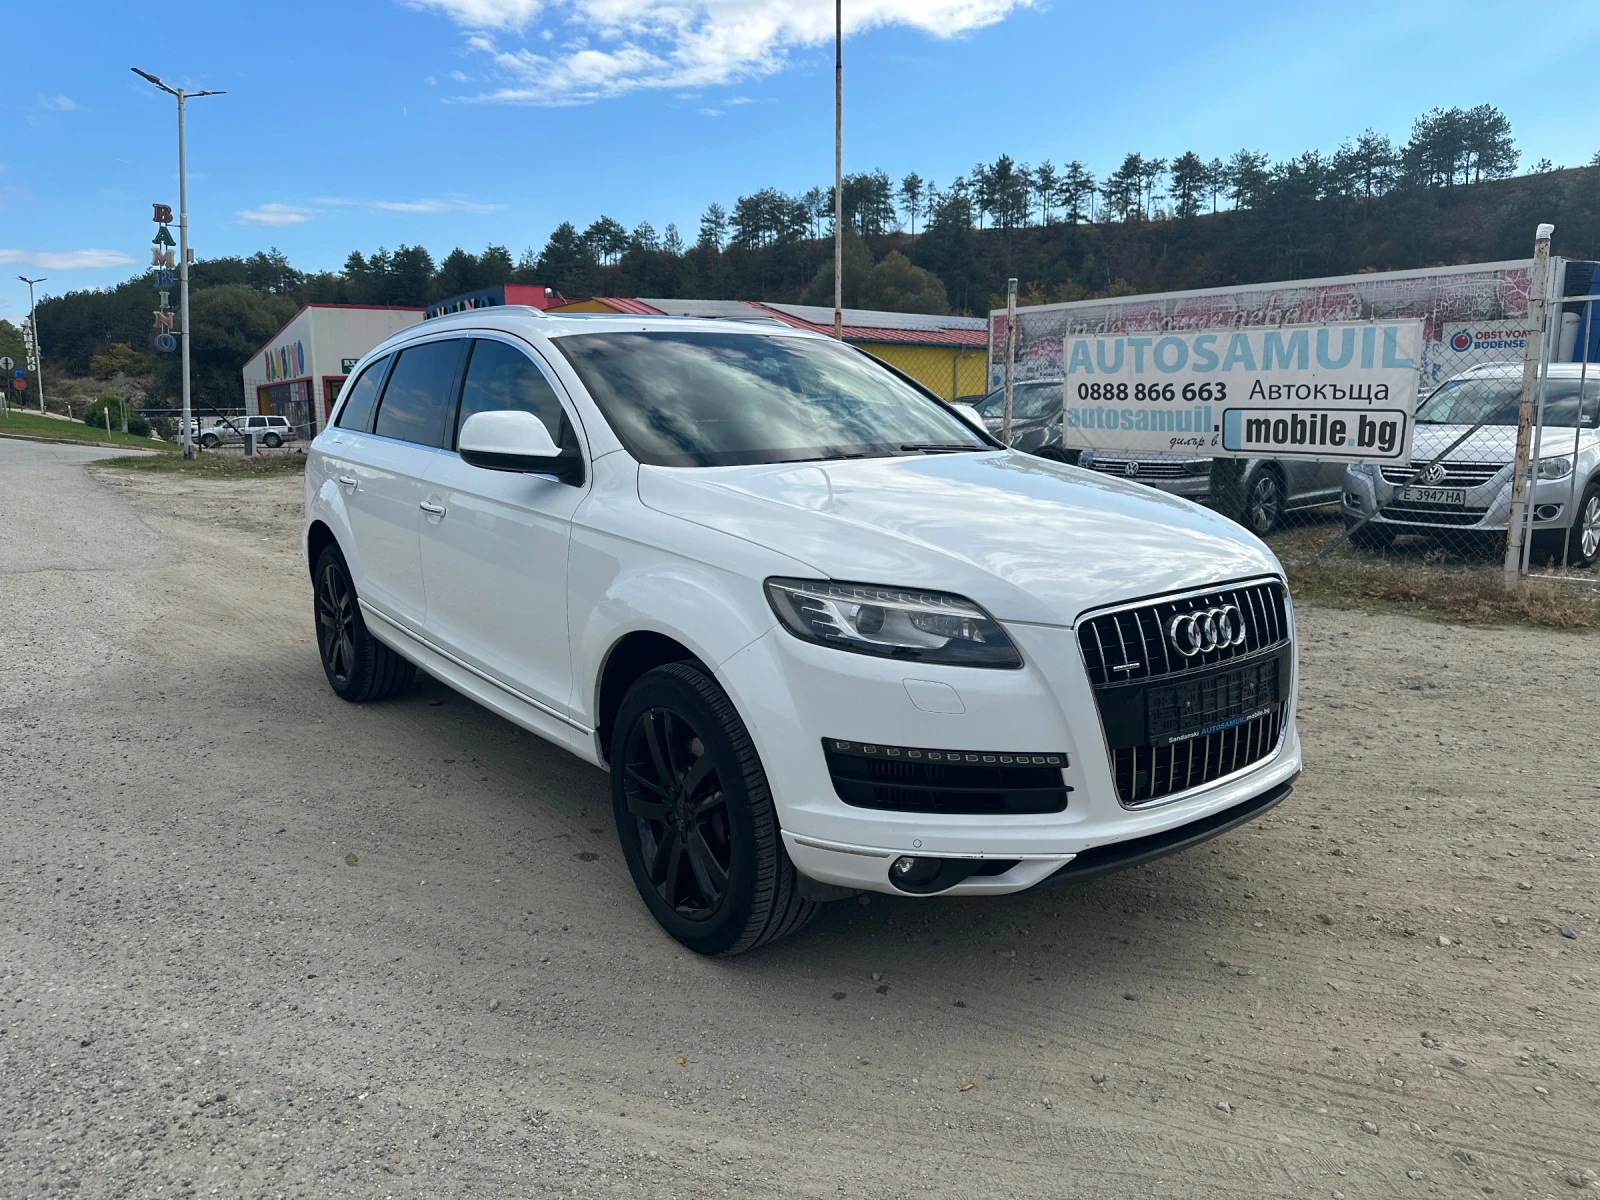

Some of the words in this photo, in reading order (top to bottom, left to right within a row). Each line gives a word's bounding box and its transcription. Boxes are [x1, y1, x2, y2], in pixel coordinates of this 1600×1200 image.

[151, 203, 176, 352] BAMBINO
[1474, 340, 1526, 350] BODENSE
[1475, 331, 1502, 340] OBST
[265, 339, 304, 382] BAMBINO
[1068, 327, 1415, 374] AUTOSAMUIL
[1077, 382, 1129, 401] 0888
[1134, 382, 1176, 401] 866
[1181, 382, 1227, 402] 663
[1249, 379, 1390, 405] Автокъща
[1245, 413, 1398, 453] mobile.bg
[1168, 730, 1200, 744] Sandanski
